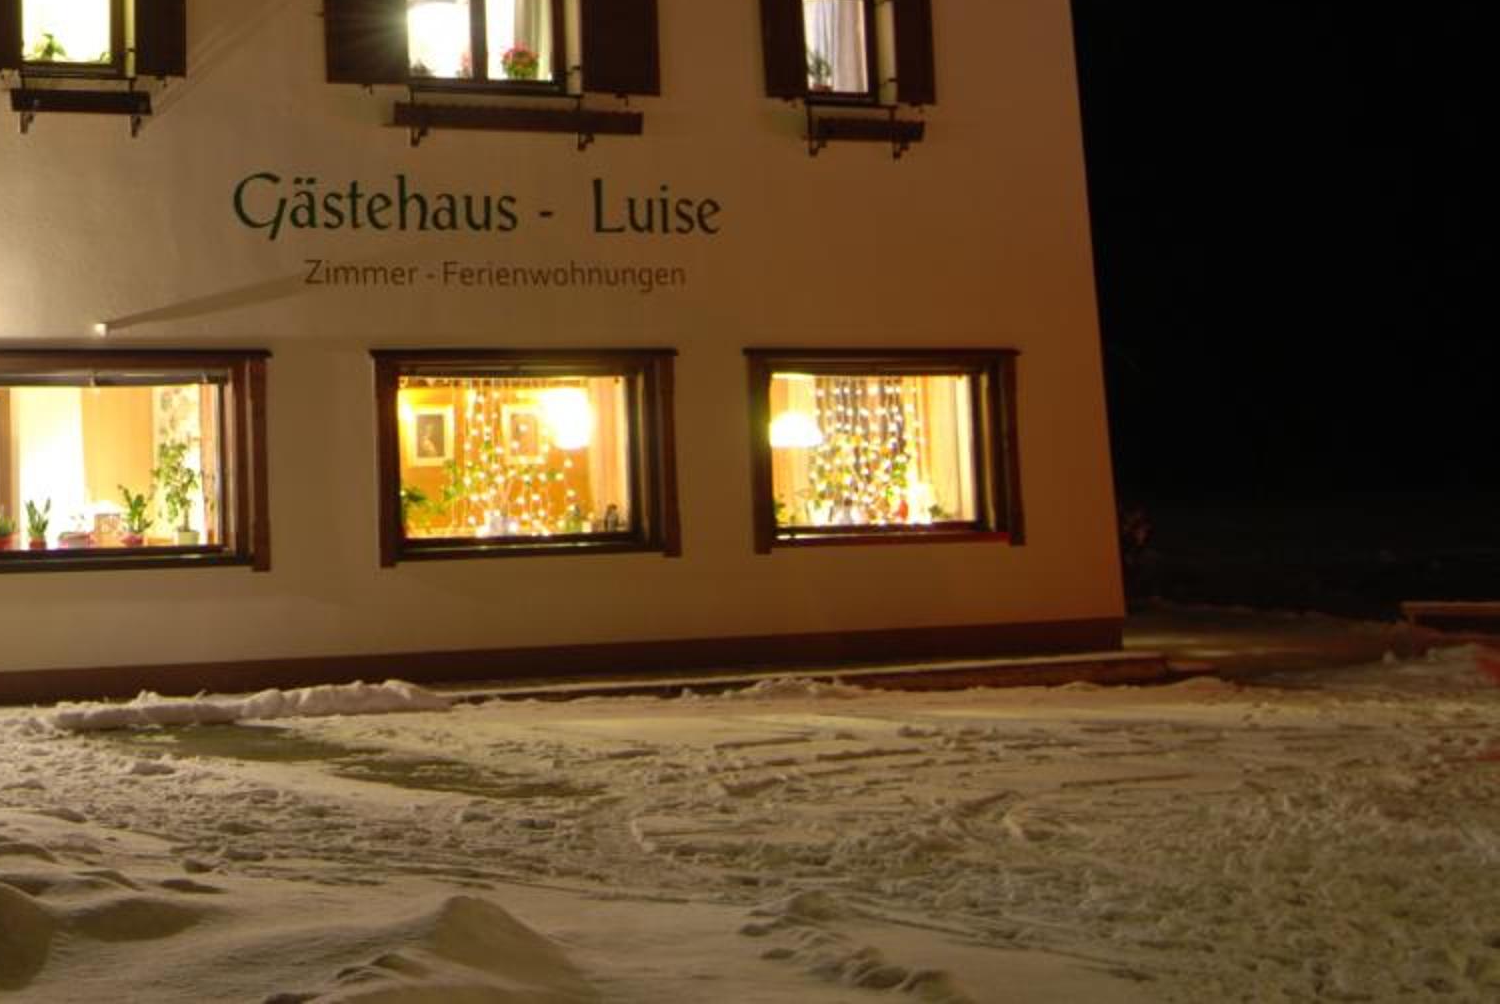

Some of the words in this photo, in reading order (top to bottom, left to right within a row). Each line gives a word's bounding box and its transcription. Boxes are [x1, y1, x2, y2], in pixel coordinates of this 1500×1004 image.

[233, 172, 518, 240] Gästehaus
[592, 178, 721, 235] Luise
[304, 260, 419, 287] Zimmer
[442, 261, 686, 293] Ferienwohnungen
